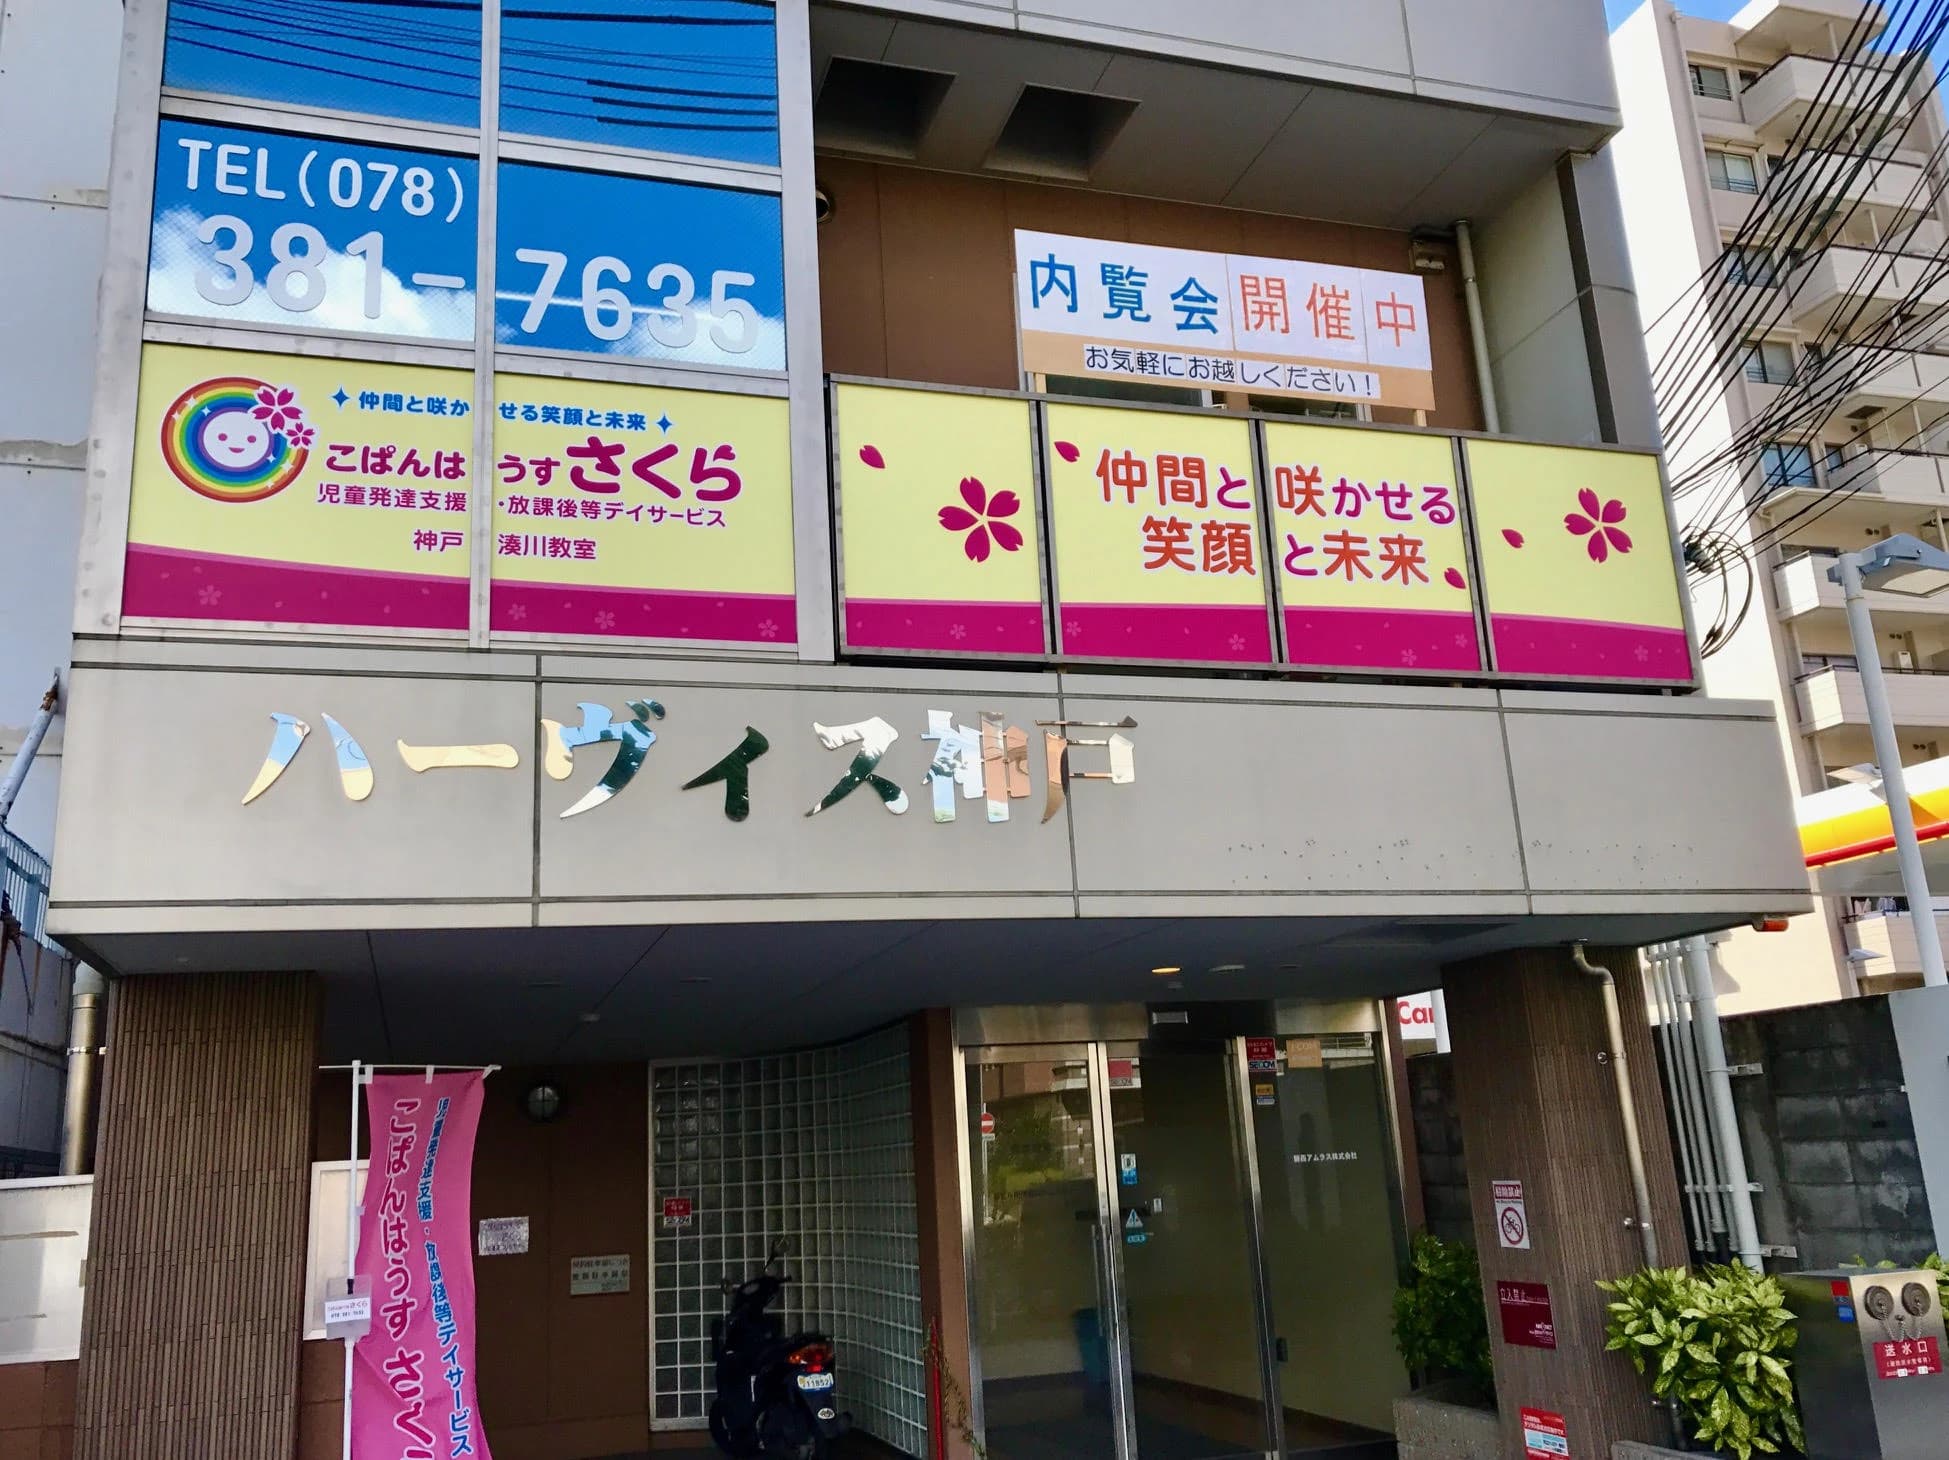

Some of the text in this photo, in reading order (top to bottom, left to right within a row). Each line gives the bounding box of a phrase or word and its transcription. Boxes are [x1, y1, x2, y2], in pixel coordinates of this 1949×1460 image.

[1030, 253, 1417, 348] 内覧会開催中
[1085, 345, 1373, 396] お気軽にお越しください！
[241, 697, 1138, 825] ハーヴィス神戸
[1884, 1340, 1928, 1357] 送水口
